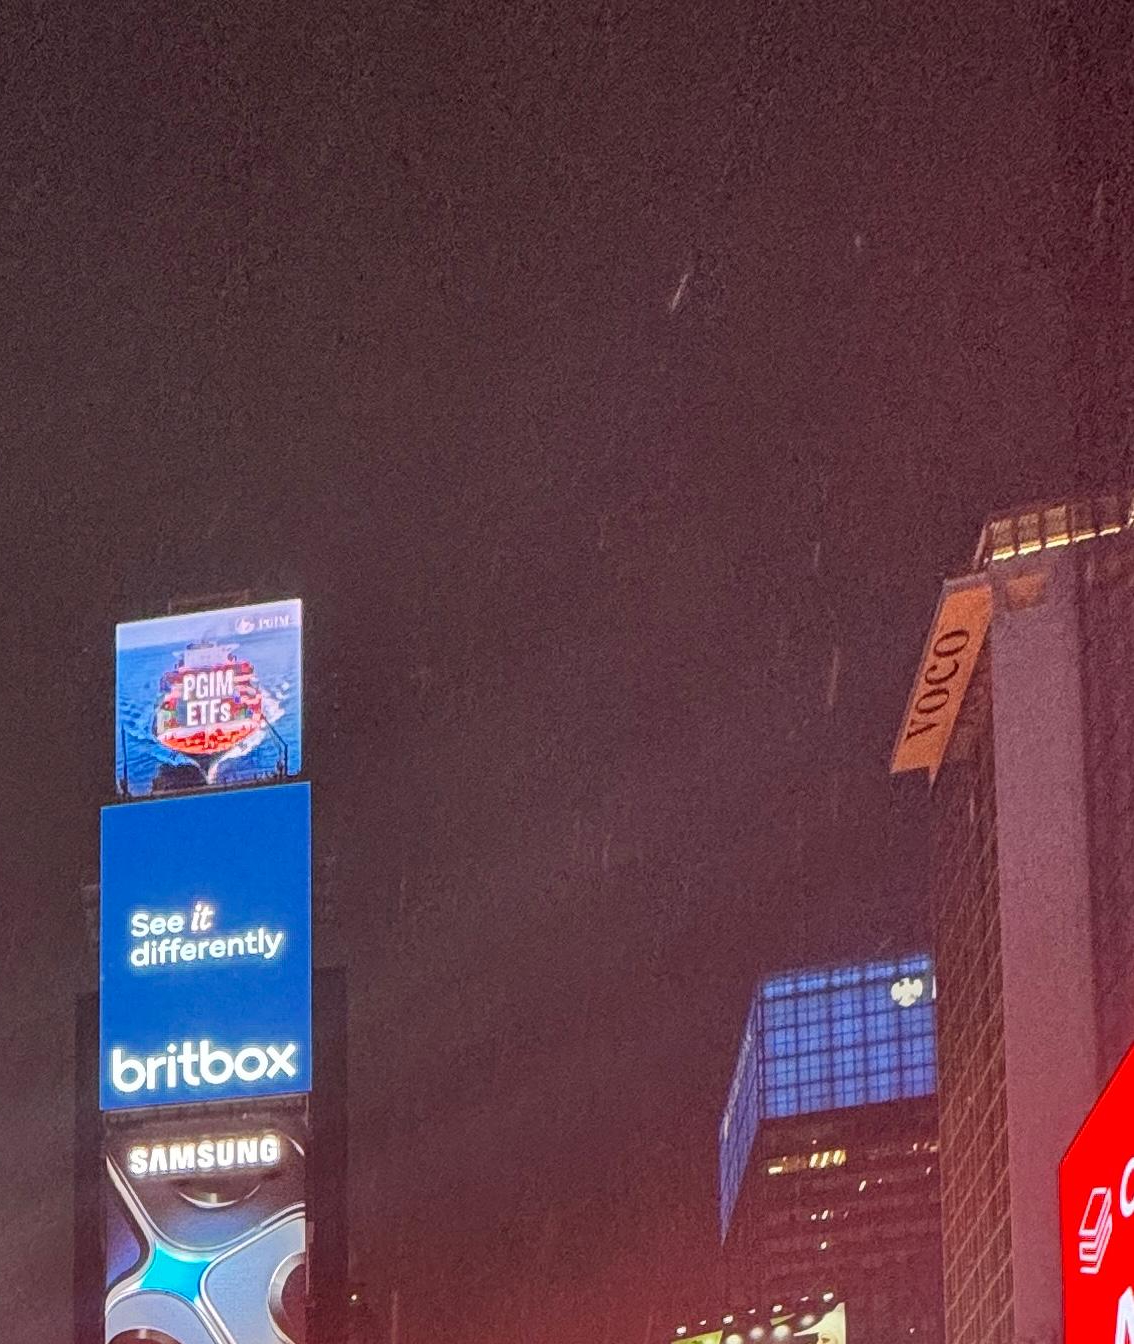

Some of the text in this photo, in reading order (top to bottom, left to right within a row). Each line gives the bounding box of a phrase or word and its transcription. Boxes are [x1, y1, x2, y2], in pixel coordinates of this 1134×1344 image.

[183, 669, 235, 701] PGIM
[186, 700, 232, 727] ETFs
[130, 903, 213, 937] See it
[130, 928, 284, 967] differently
[112, 1040, 297, 1093] britbox
[129, 1136, 281, 1175] SAMSUNG
